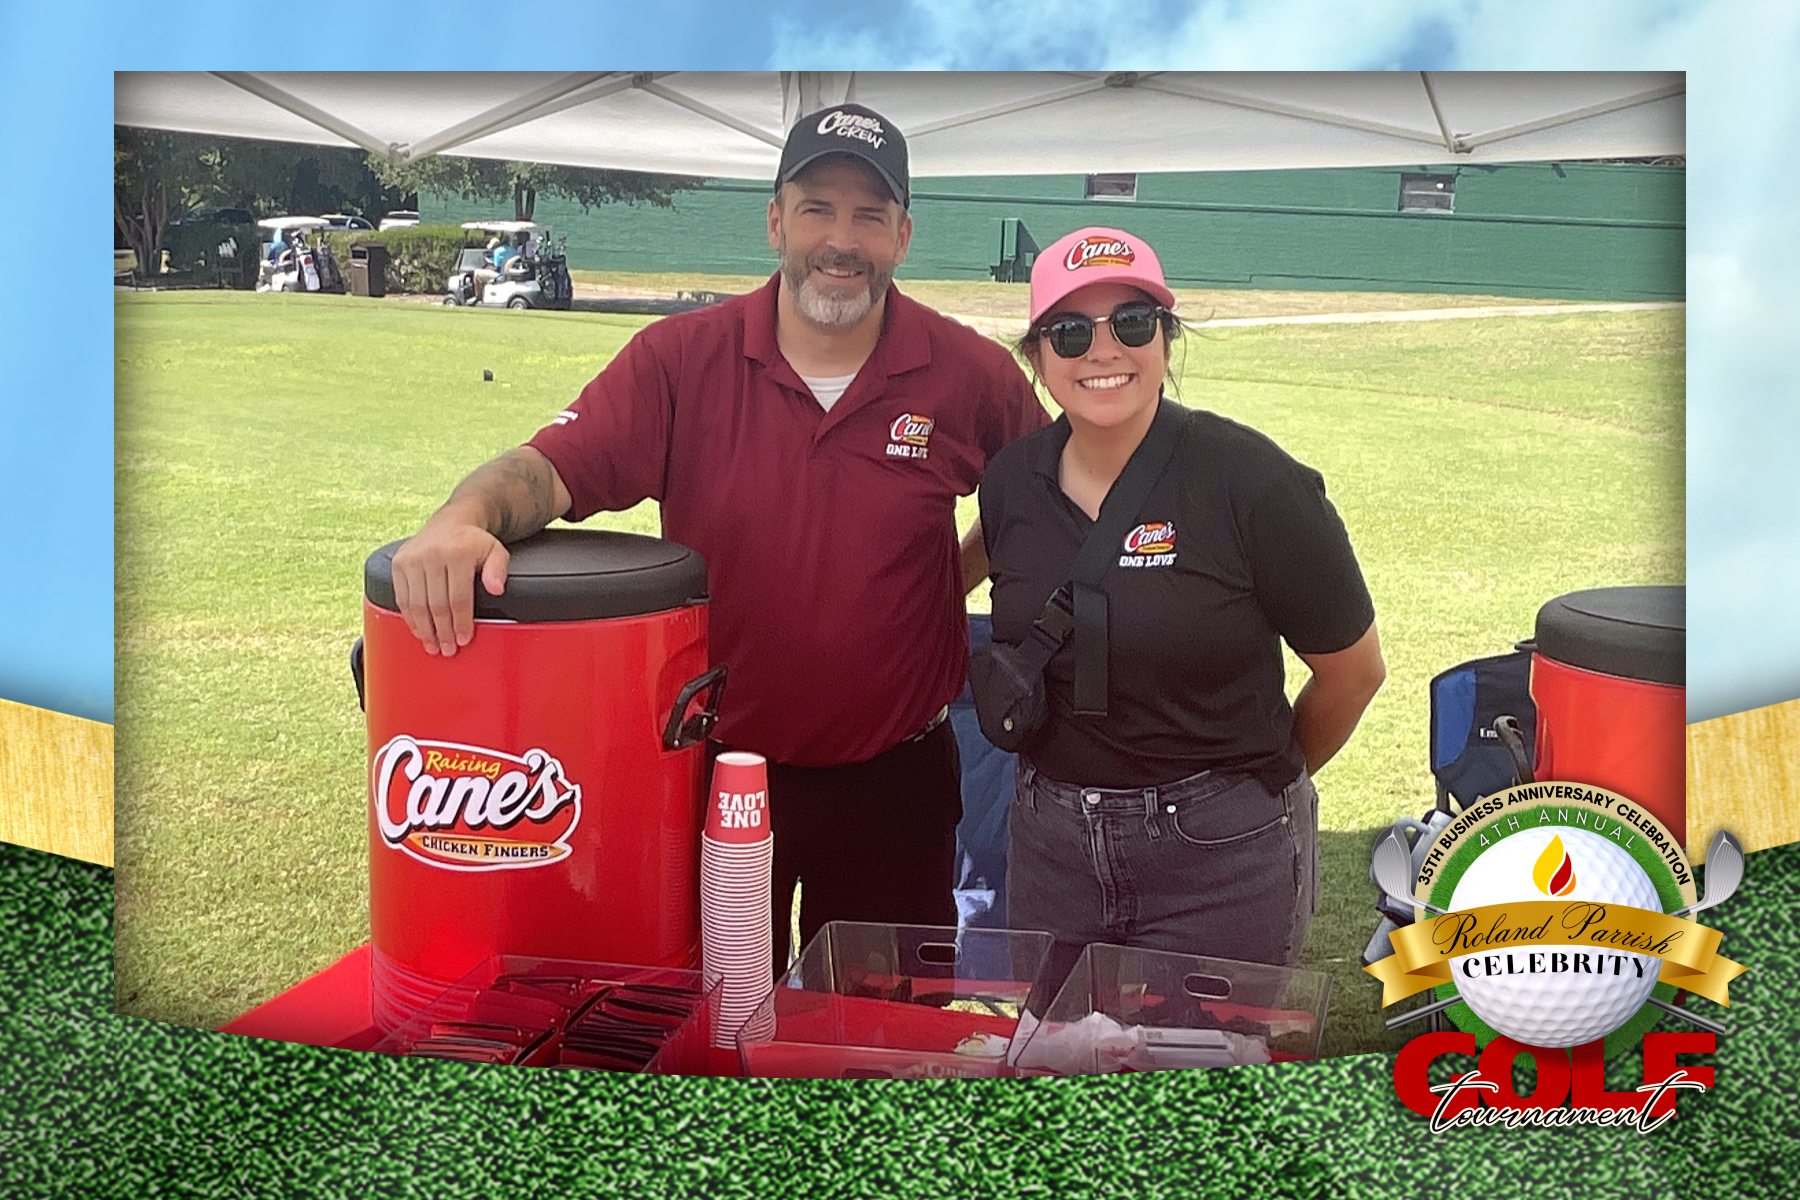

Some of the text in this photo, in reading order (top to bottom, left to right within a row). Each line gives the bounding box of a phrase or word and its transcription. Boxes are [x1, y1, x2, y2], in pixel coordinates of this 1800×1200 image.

[817, 110, 884, 134] Cane's
[836, 126, 887, 149] CREW
[1067, 239, 1133, 270] Cane's
[886, 443, 910, 457] ONE
[1124, 521, 1175, 552] Cane's
[1119, 553, 1177, 567] ONE LOVE
[425, 750, 501, 778] Raising
[378, 738, 575, 844] Cane's
[718, 790, 766, 811] LOVE
[721, 809, 761, 828] ONE
[422, 835, 548, 857] CHICKEN FINGERS
